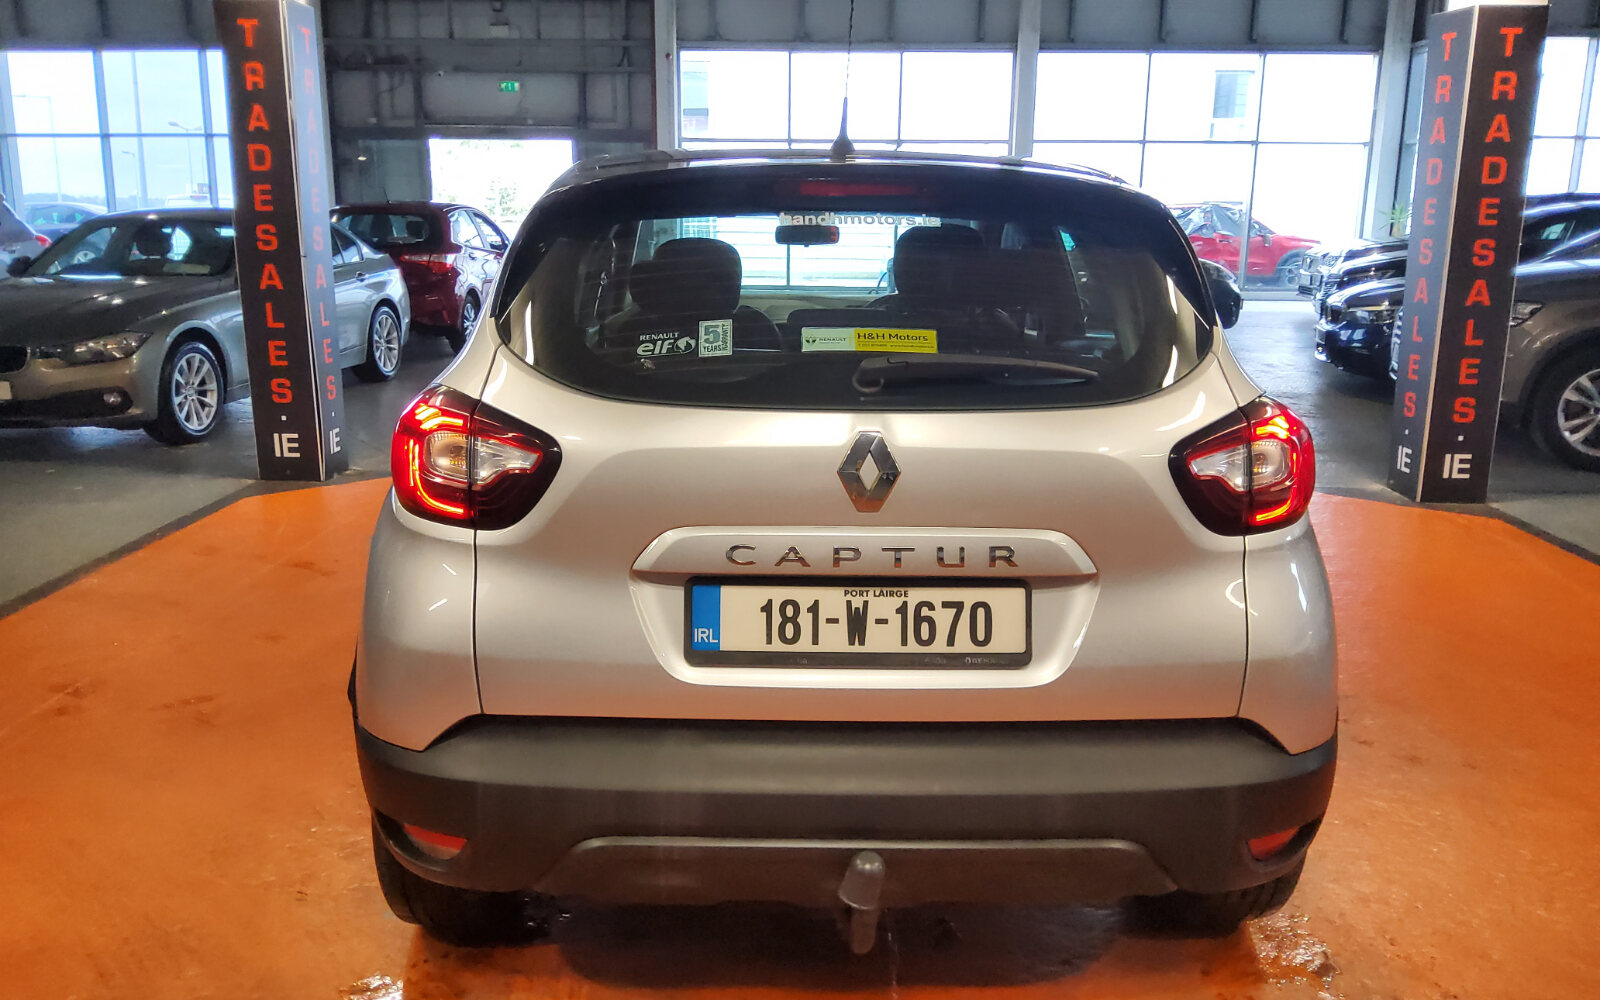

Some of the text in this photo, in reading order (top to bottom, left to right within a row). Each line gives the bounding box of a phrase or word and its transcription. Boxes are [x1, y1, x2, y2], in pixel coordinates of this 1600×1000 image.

[779, 212, 942, 227] handhmotors.ie
[640, 332, 679, 341] RENAULT
[703, 324, 720, 345] 5
[857, 332, 928, 341] H&H Motors
[636, 339, 675, 356] elf
[703, 345, 721, 353] YEARS
[725, 543, 1019, 569] CAPTUR
[843, 589, 870, 598] PORT
[760, 598, 993, 648] 181-W-1670
[694, 628, 719, 644] IRL
